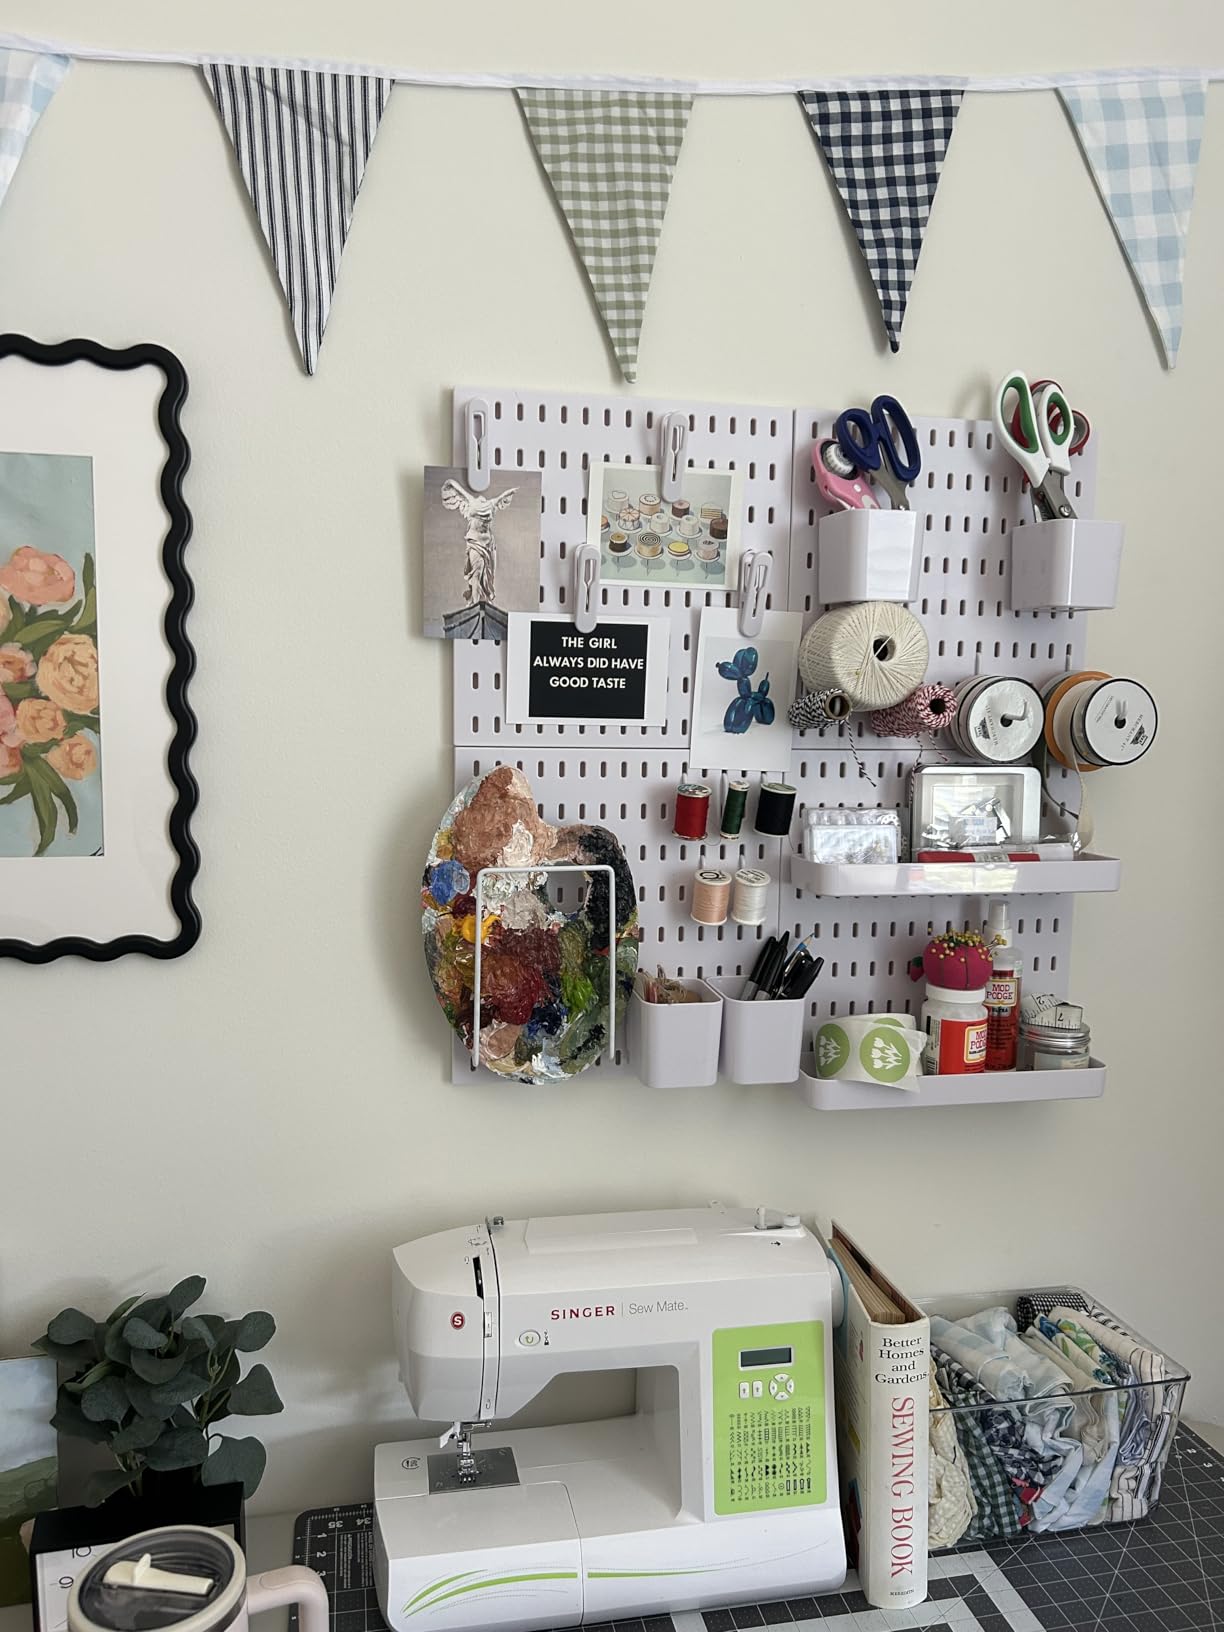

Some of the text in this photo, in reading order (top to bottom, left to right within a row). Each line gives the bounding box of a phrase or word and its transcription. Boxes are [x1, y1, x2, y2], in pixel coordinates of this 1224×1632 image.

[561, 636, 617, 649] THE GIRL
[533, 656, 644, 669] ALWAYS DID HAVE
[549, 676, 626, 689] GOOD TASTE
[992, 984, 1010, 992] MOD
[986, 991, 1013, 1000] PODGE
[551, 1305, 615, 1320] SINGER
[629, 1303, 653, 1315] Sew
[453, 1315, 463, 1326] S
[882, 1337, 922, 1348] Better
[879, 1348, 925, 1360] Homes
[891, 1360, 916, 1372] and
[891, 1397, 915, 1578] SEWING BOOK
[328, 1517, 371, 1529] 34 35
[59, 1576, 74, 1588] 9
